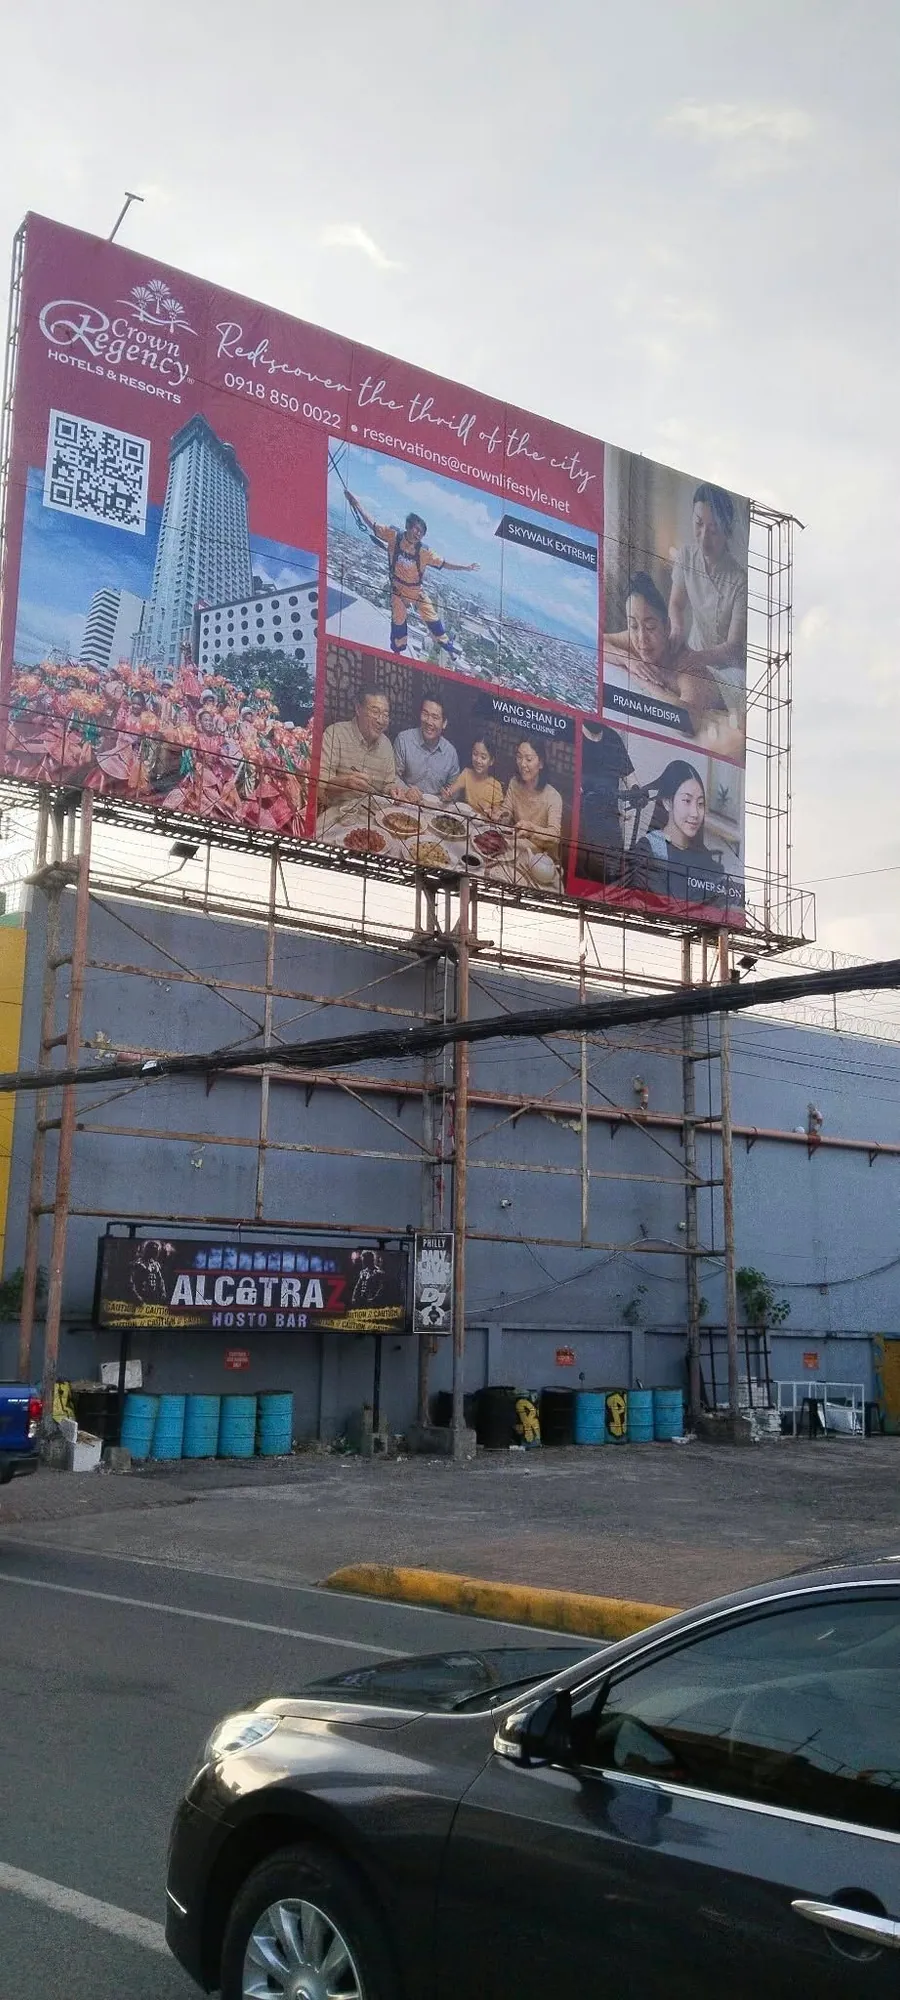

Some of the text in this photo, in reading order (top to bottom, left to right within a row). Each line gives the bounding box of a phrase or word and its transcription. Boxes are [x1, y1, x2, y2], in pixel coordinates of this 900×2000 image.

[39, 299, 190, 386] Regency
[112, 318, 180, 357] Crown
[47, 348, 181, 404] HOTELS & RESORTS
[215, 322, 596, 494] Rediscover the thrill of the city
[224, 372, 571, 514] 0918 850 0022 reservations@crownlifestyle.net
[508, 523, 596, 565] SKYWALK EXTREME
[492, 699, 567, 730] WANG SHAN LO
[503, 715, 556, 736] CHINESE CUISINE
[613, 694, 681, 724] PRANA MEDISPA
[687, 877, 742, 898] TOWER SAON
[423, 1238, 446, 1248] PHILLY
[212, 1311, 267, 1328] HOSTO
[275, 1313, 308, 1328] BAR
